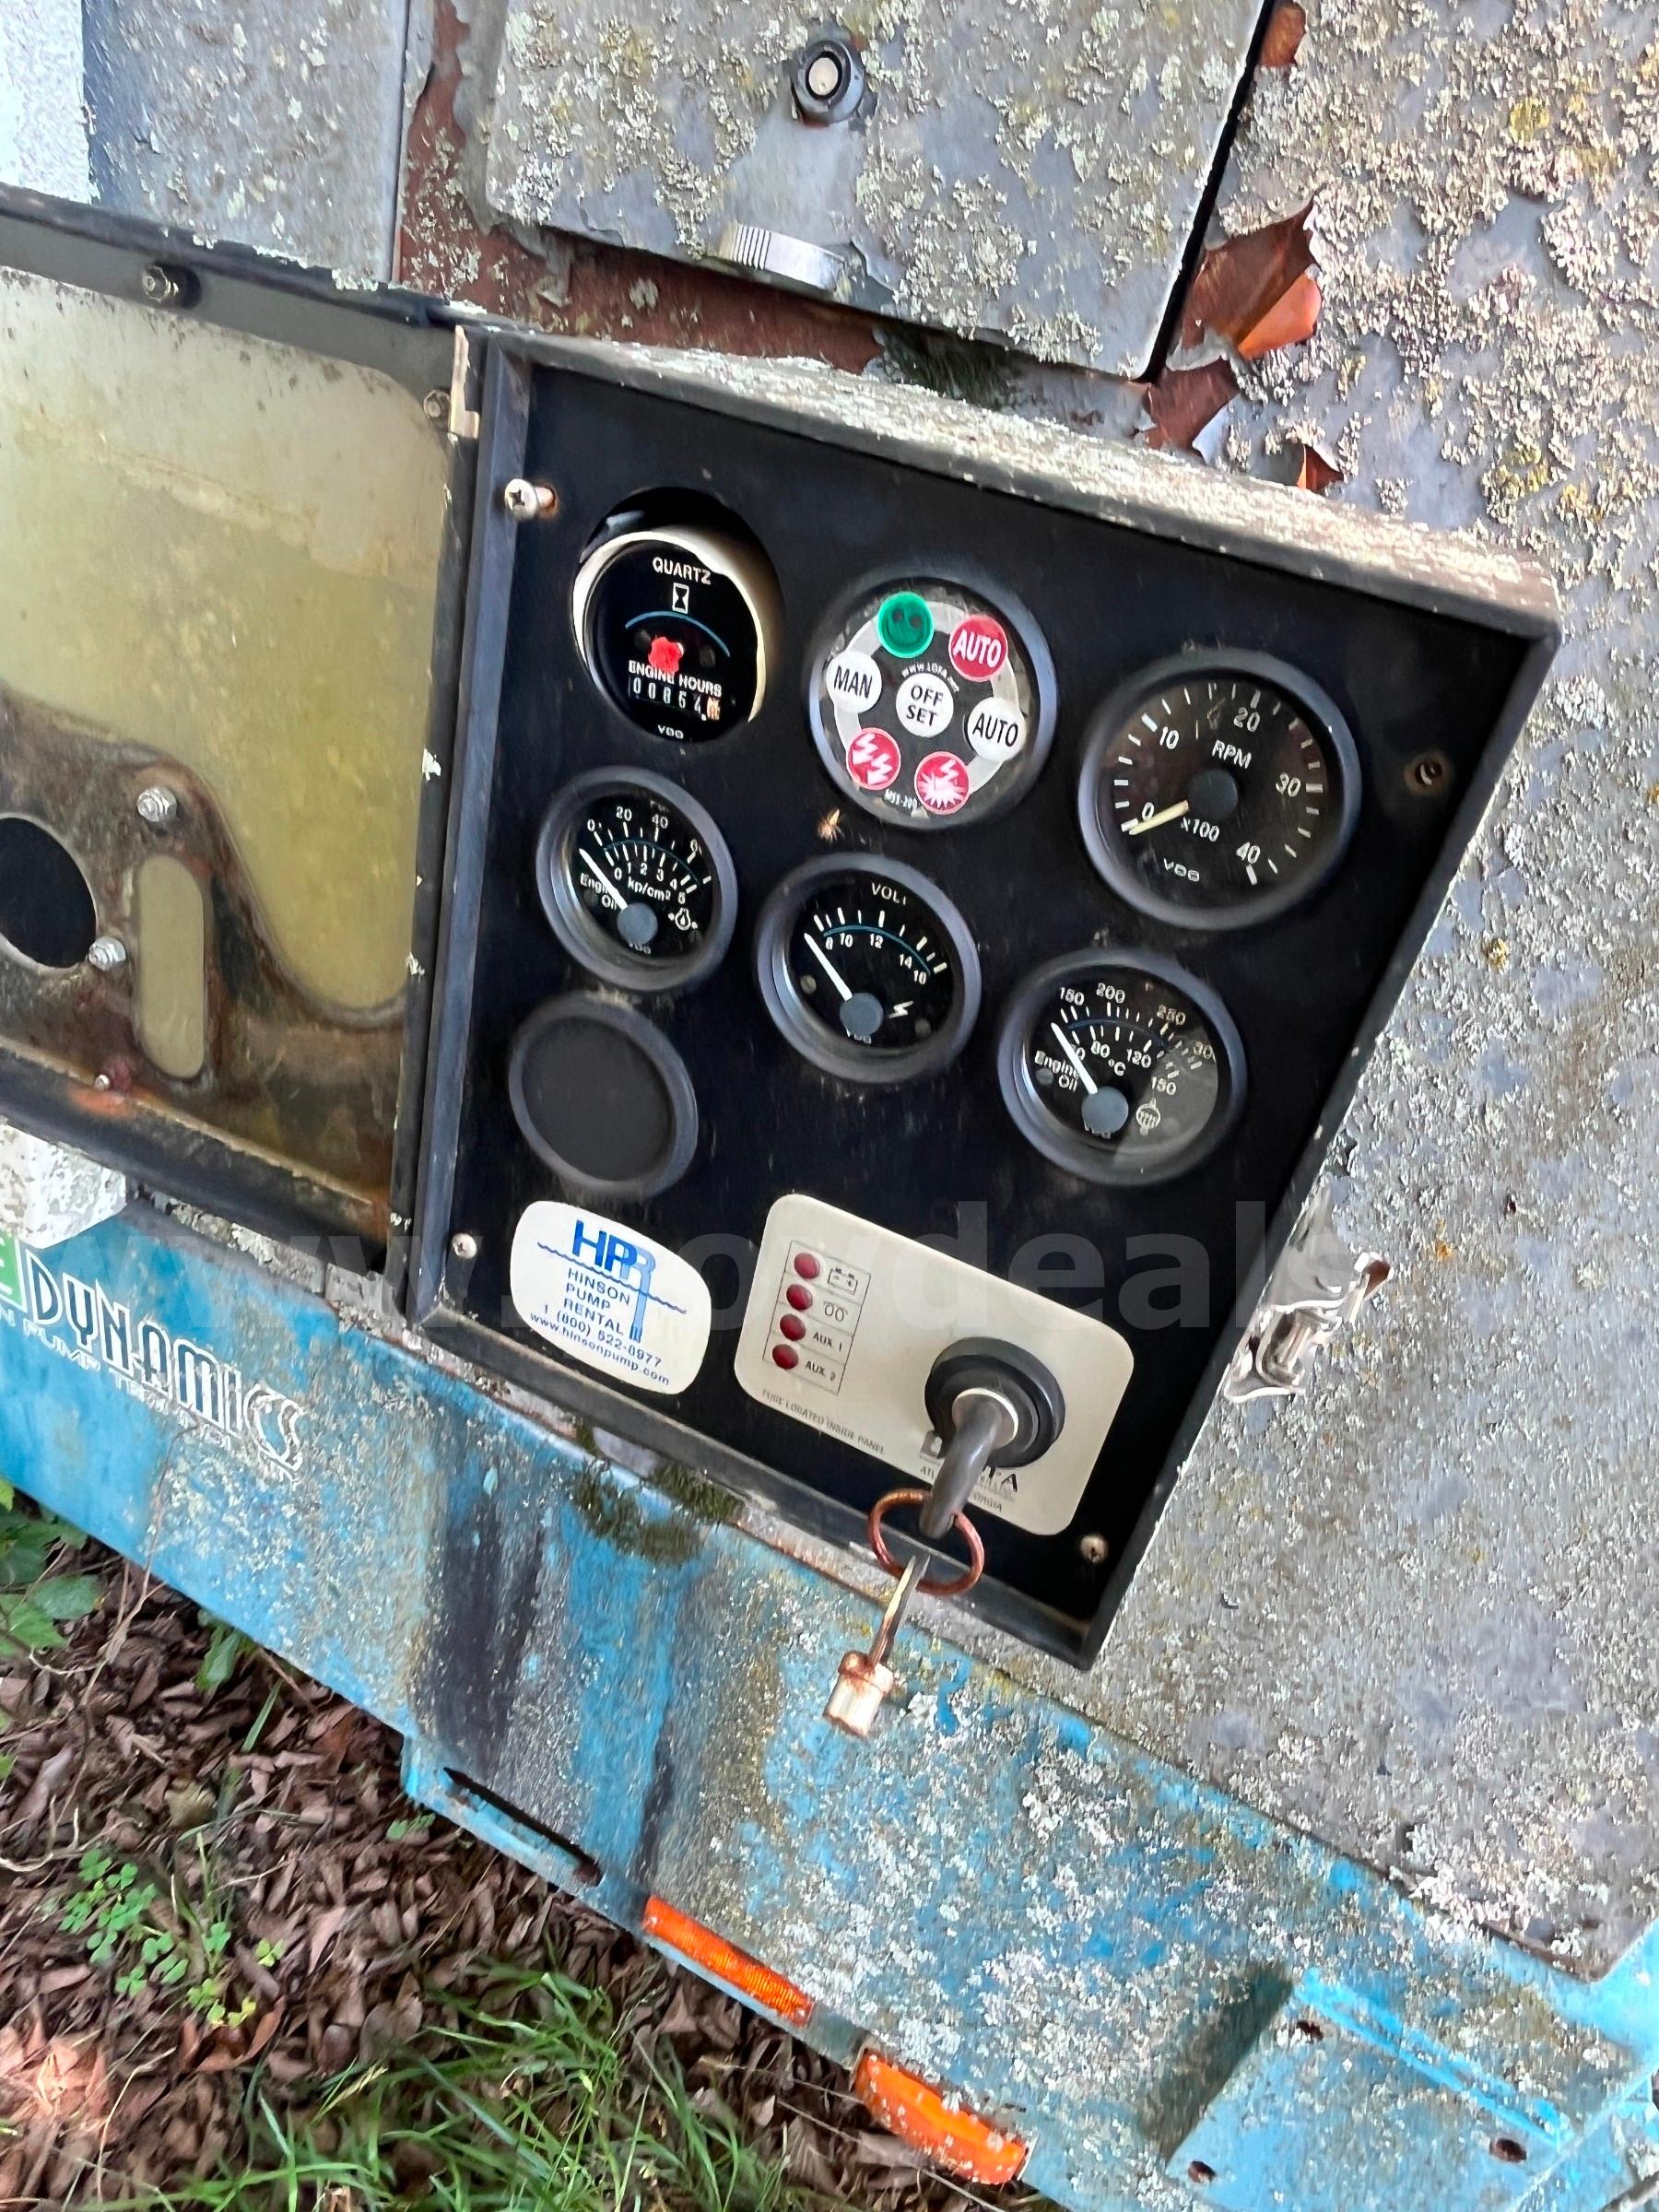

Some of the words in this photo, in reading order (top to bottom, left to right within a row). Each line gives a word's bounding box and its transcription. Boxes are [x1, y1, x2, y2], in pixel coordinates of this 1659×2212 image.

[653, 557, 712, 585] QUARTZ
[952, 629, 1001, 667] AUTO
[629, 660, 675, 684] ENGINE
[678, 673, 722, 698] HOURS
[833, 665, 873, 700] MAN
[910, 685, 944, 706] OFF
[906, 704, 937, 727] SET
[1233, 707, 1261, 732] 20
[972, 712, 1018, 747] AUTO
[1159, 726, 1180, 749] 10
[1211, 739, 1253, 770] RPM
[1275, 771, 1301, 797] 30
[616, 806, 632, 821] 20
[1141, 801, 1155, 820] 0
[587, 818, 595, 832] 0
[652, 814, 668, 829] 40
[1236, 841, 1261, 865] 40
[614, 867, 622, 881] 0
[628, 862, 632, 874] 1
[640, 863, 648, 876] 2
[656, 868, 664, 881] 3
[669, 878, 677, 890] 4
[601, 894, 617, 910] Oil
[826, 936, 833, 950] 8
[840, 933, 853, 947] 10
[870, 933, 883, 949] 12
[900, 954, 912, 969] 14
[1096, 982, 1125, 1004] 200
[1090, 1041, 1110, 1058] 80
[1126, 1048, 1151, 1068] 120
[1058, 1074, 1077, 1092] Oil
[566, 1282, 611, 1310] PUMP
[568, 1267, 631, 1306] HINSON
[557, 1310, 592, 1336] (800)
[563, 1298, 624, 1335] RENTAL
[530, 1312, 670, 1386] www.hinsonpump.com
[26, 1248, 304, 1472] DYNAMICS
